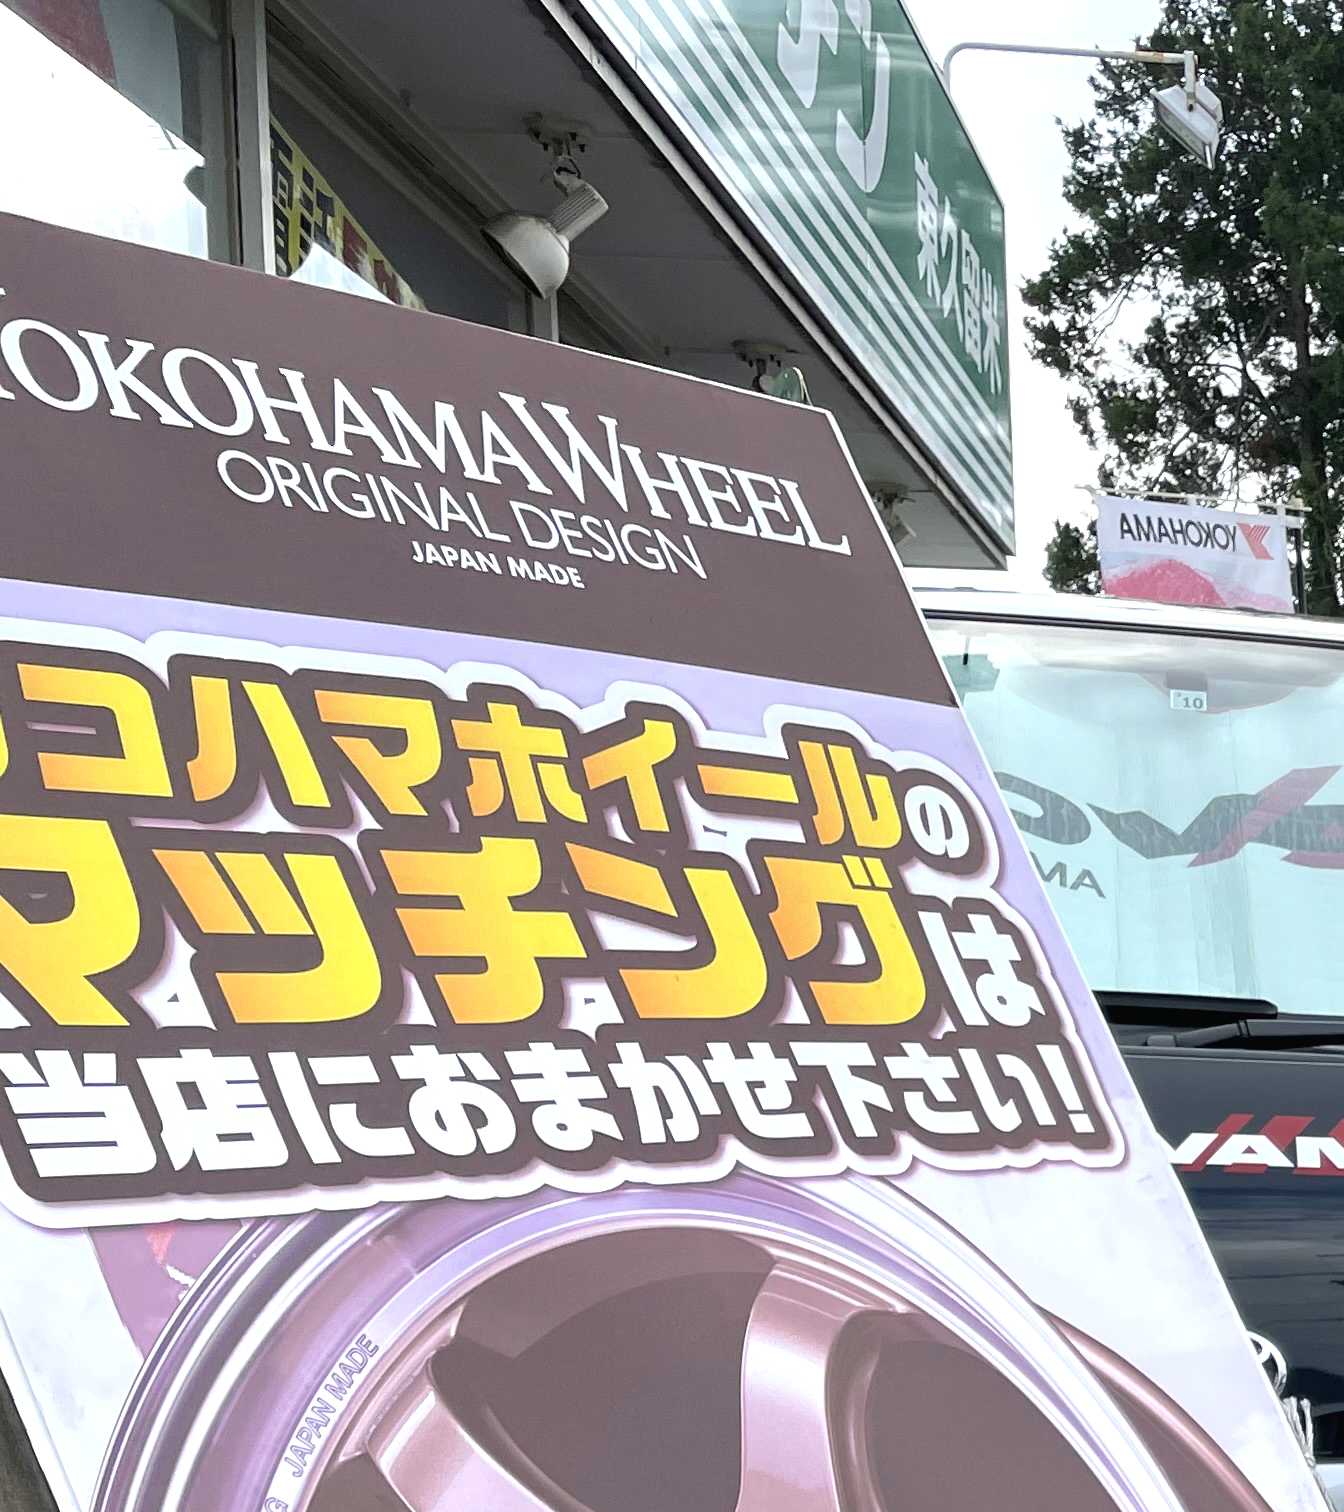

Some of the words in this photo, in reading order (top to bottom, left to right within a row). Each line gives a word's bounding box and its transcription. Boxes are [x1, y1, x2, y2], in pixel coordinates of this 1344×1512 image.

[914, 151, 1000, 395] 東久留米
[216, 450, 511, 545] ORIGINAL
[523, 503, 707, 581] DESIGN
[411, 541, 501, 576] JAPAN
[508, 555, 585, 590] MADE
[0, 663, 969, 861] コハマホイールの
[0, 811, 1032, 1027] マッチングは
[4, 1048, 1097, 1178] 当店におまかせ下さい!
[284, 1398, 335, 1479] JAPAN
[328, 1333, 380, 1401] MADE
